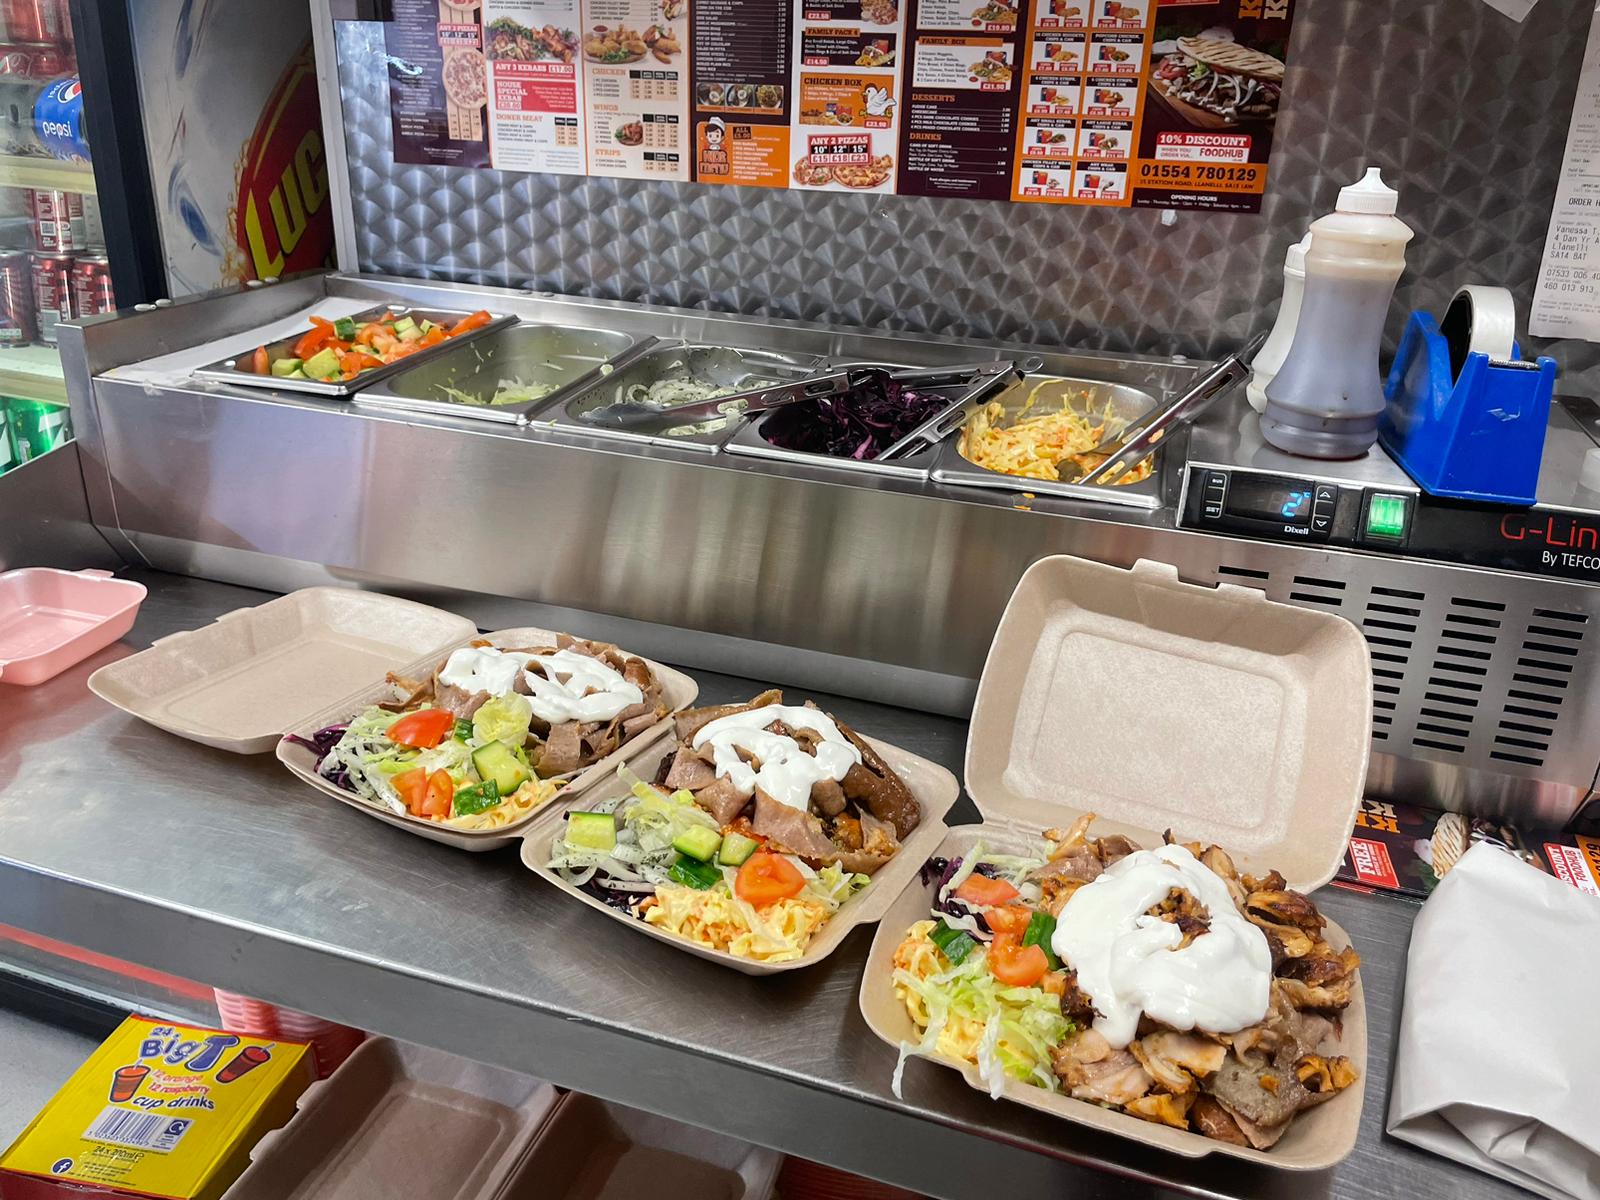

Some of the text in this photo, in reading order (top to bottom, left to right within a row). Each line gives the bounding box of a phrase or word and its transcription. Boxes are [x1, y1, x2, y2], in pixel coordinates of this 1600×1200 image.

[912, 94, 955, 102] DESSERTS
[42, 120, 72, 140] pepsi
[837, 136, 868, 144] PIZZAS
[1160, 135, 1246, 146] 10% DISCOUNT
[1200, 148, 1244, 158] FOODHUB
[1141, 164, 1257, 182] 01554 780129
[1568, 197, 1592, 206] ORDER
[1556, 225, 1588, 234] Vanessa
[1552, 242, 1589, 252] Llanelli
[1546, 269, 1570, 278] 07533
[1573, 271, 1588, 279] 006
[1544, 282, 1594, 294] 460 013 913
[1284, 525, 1310, 536] Dixell
[1542, 550, 1600, 570] By TEFCO
[1350, 840, 1376, 875] FREE
[1564, 850, 1588, 881] FOODHUB
[140, 1034, 200, 1064] Big
[163, 1074, 204, 1084] orange
[148, 1082, 210, 1095] 12 raspberry
[133, 1096, 214, 1110] cup drinks
